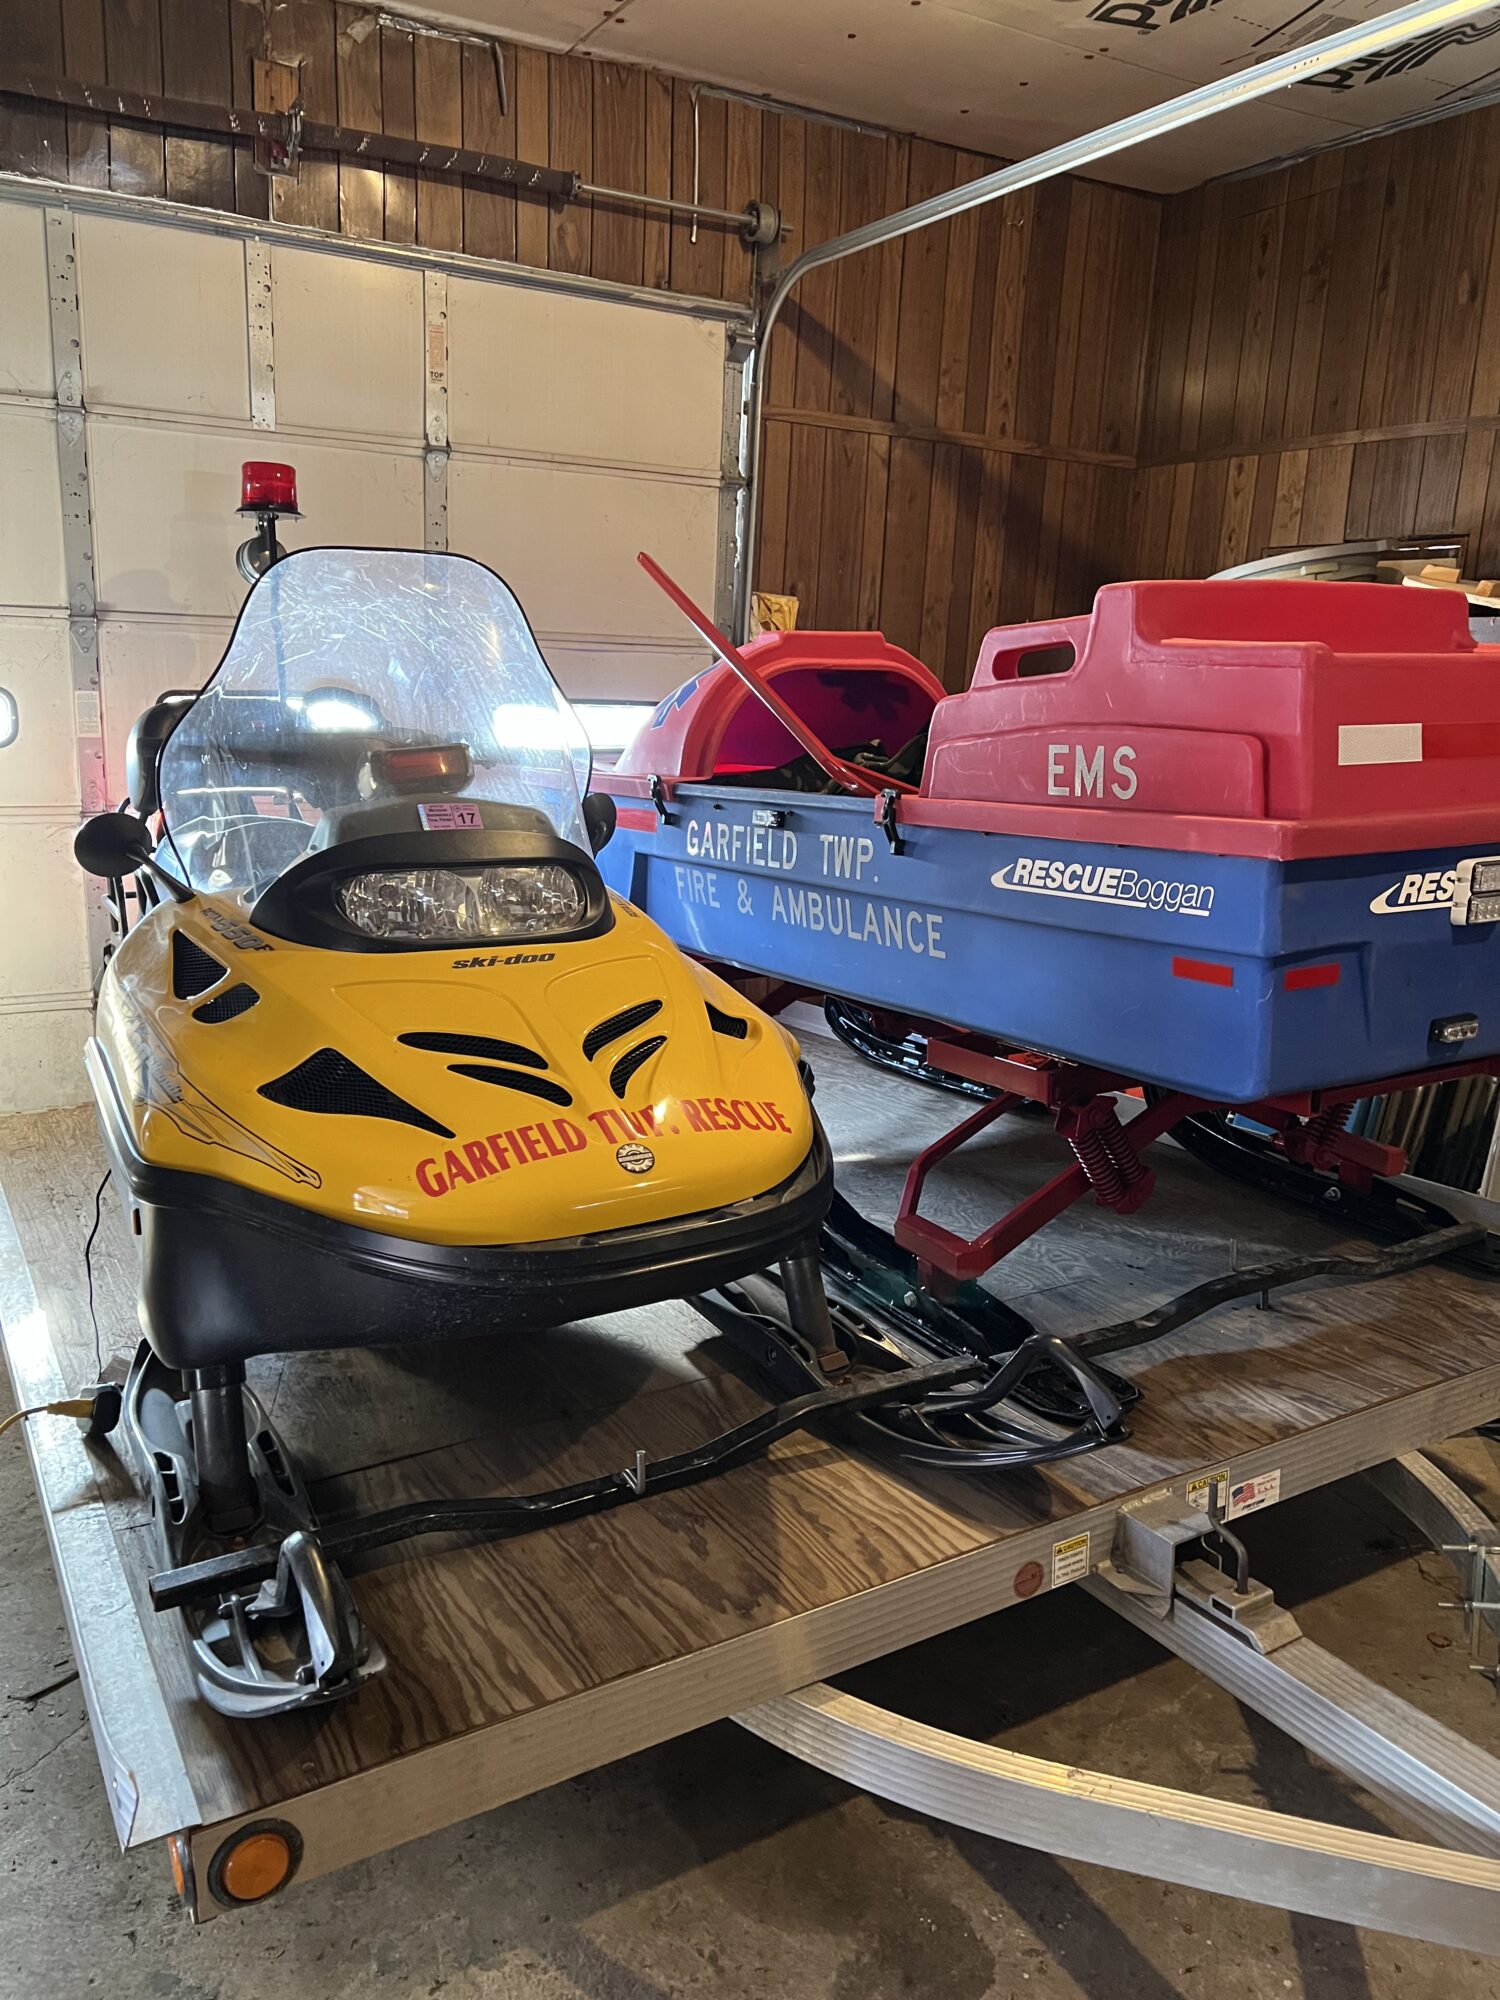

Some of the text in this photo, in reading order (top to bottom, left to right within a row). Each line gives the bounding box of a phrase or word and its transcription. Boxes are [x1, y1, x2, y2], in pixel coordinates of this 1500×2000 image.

[1047, 744, 1138, 800] EMS
[458, 813, 475, 824] 17
[686, 819, 880, 883] GARFIELD TWP.
[674, 866, 720, 909] FIRE
[737, 878, 754, 916] &
[771, 885, 946, 959] AMBULANCE
[452, 953, 556, 969] ski-doo
[415, 1098, 793, 1198] GARFIELD TWP. RESCUE
